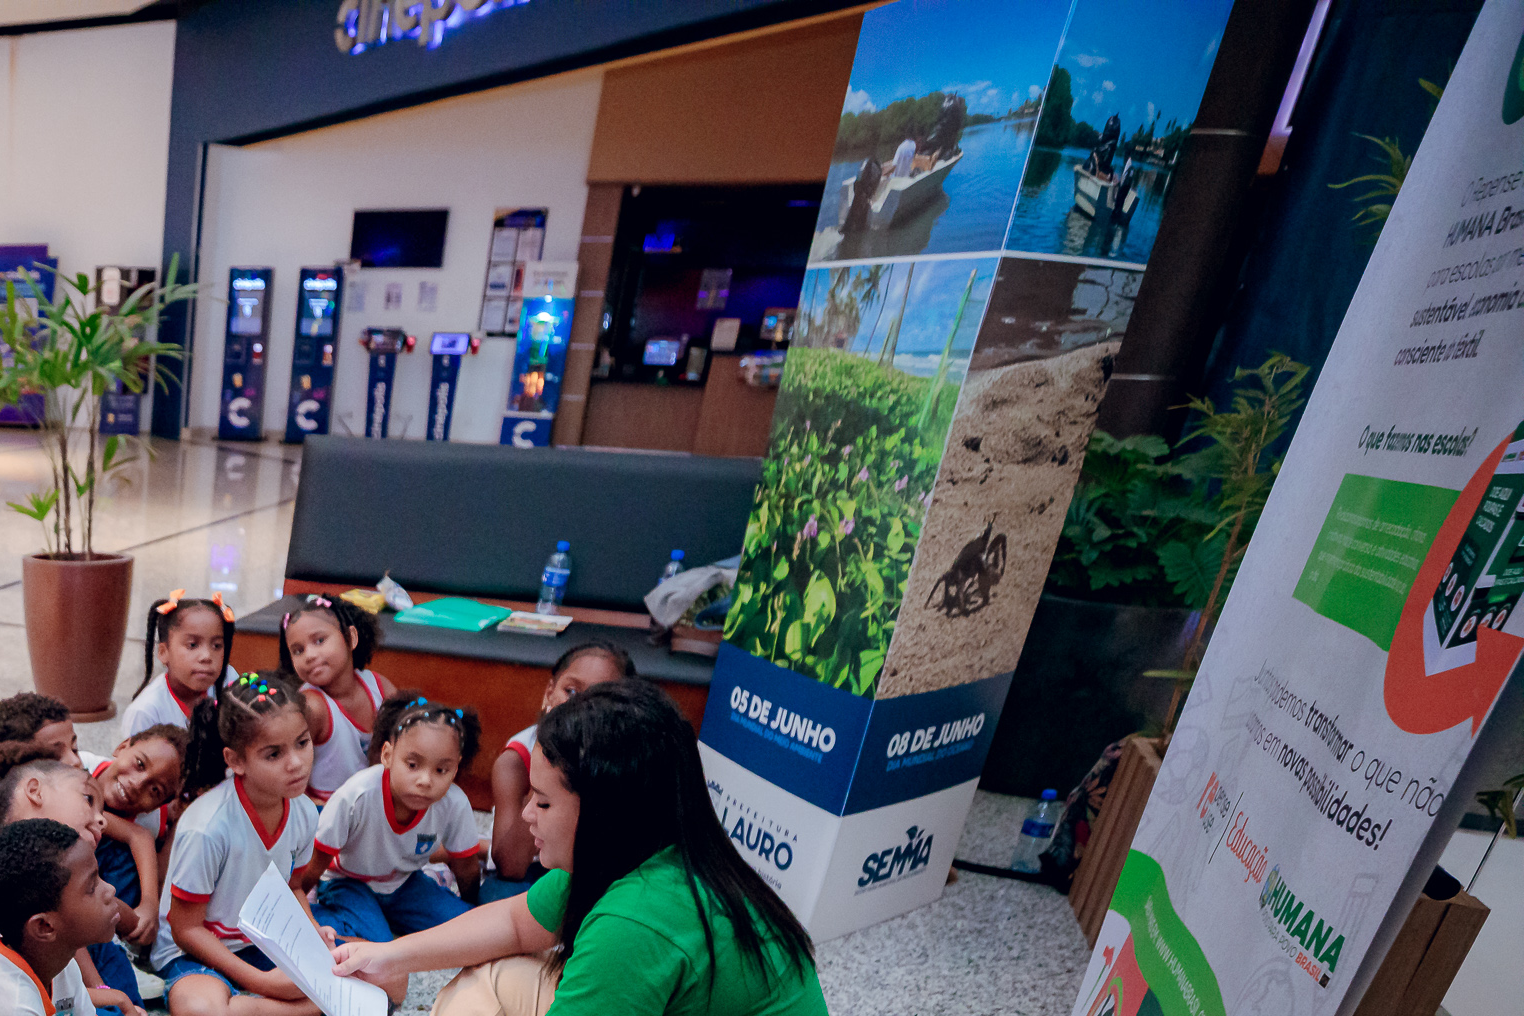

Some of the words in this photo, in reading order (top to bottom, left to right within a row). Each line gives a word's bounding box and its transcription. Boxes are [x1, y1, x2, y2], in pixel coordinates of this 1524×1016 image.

[1442, 209, 1497, 249] HUMANA
[1447, 251, 1493, 284] escolas
[1409, 291, 1471, 329] sustentável
[1393, 338, 1447, 367] consciente
[1363, 430, 1386, 457] que
[1409, 432, 1435, 455] nas
[730, 685, 748, 714] 05
[748, 692, 773, 725] DE
[770, 706, 837, 753] JUNHO
[886, 731, 911, 759] 08
[909, 725, 937, 754] DE
[933, 712, 986, 748] JUNHO
[1304, 699, 1354, 764] transformar
[1350, 750, 1365, 773] o
[1364, 756, 1402, 794] que
[1400, 777, 1445, 818] não
[1262, 731, 1282, 757] em
[1276, 742, 1310, 782] novas
[1298, 765, 1393, 850] possibilidades!
[721, 805, 794, 871] LAURO
[726, 794, 799, 844] PREFEITURA
[857, 832, 934, 889] SEMMA
[1226, 810, 1269, 884] Educação
[1267, 875, 1346, 974] HUMANA
[1294, 951, 1323, 984] BRASIL
